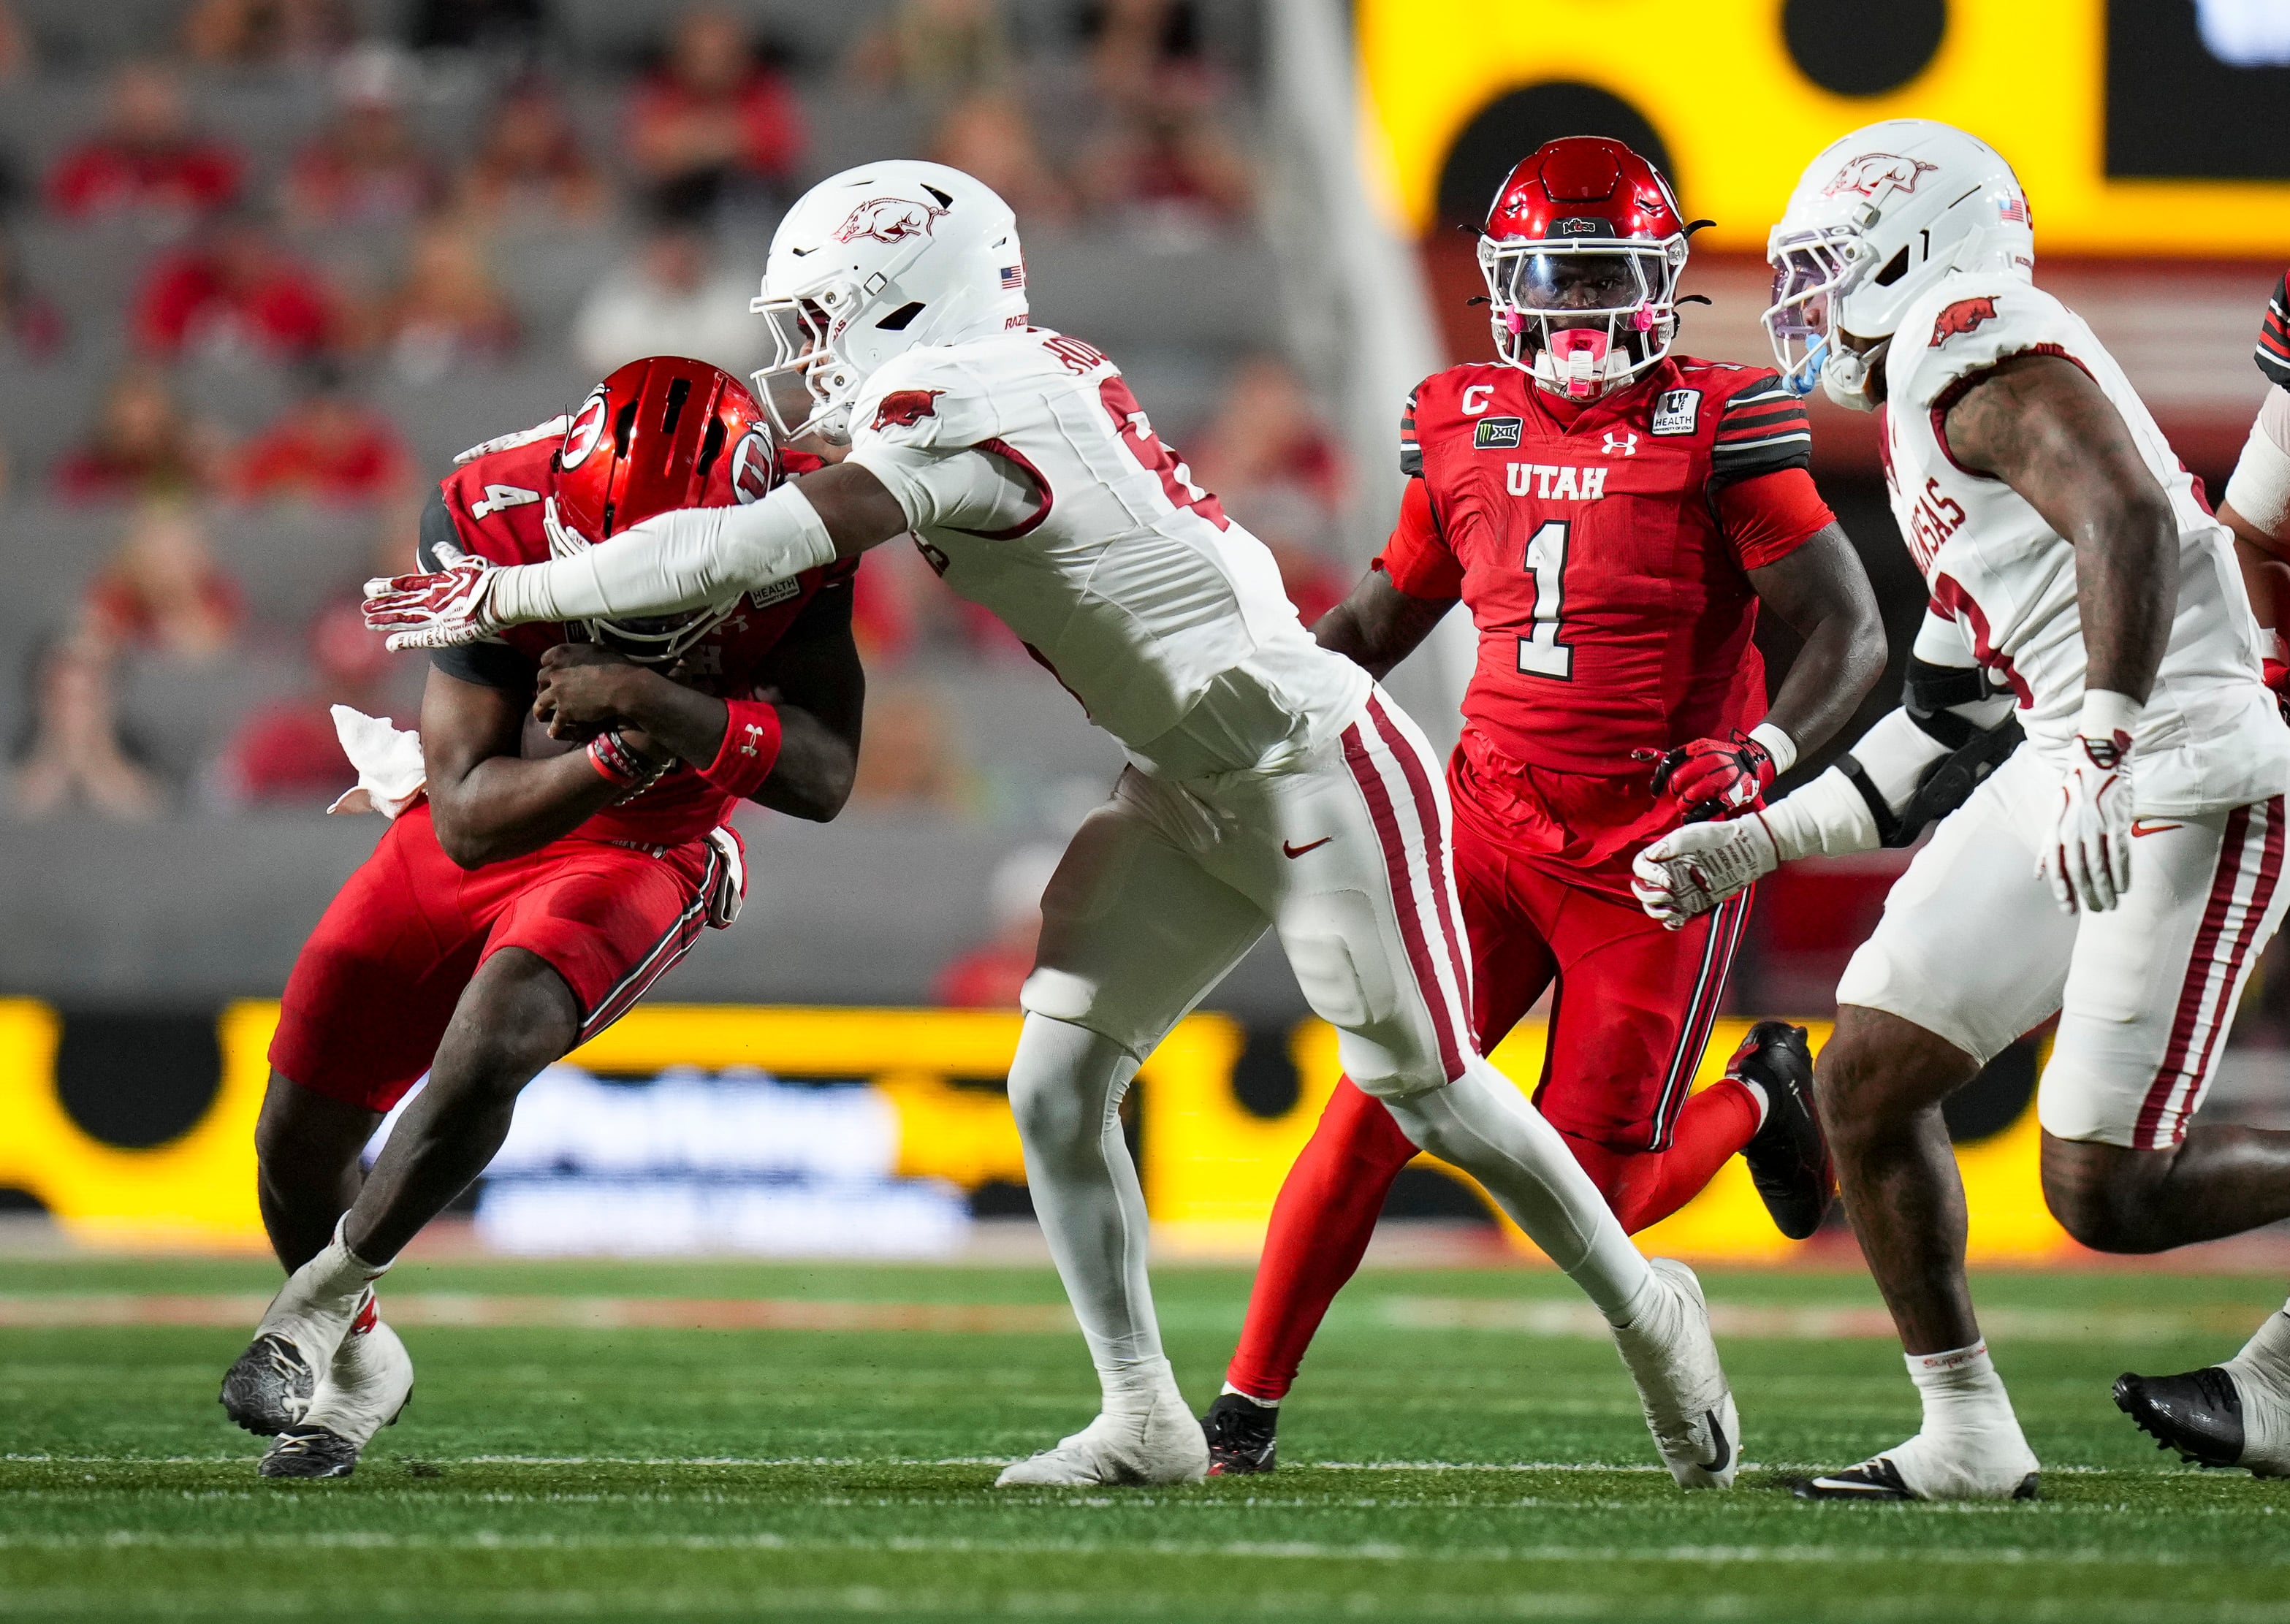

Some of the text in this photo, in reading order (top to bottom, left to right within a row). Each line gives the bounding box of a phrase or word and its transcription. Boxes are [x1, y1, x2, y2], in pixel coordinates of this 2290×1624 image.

[1461, 384, 1494, 415] C
[1655, 416, 1692, 427] HEALTH
[1506, 462, 1608, 500] UTAH
[470, 483, 541, 522] 4
[753, 578, 796, 601] HEALTH
[1516, 519, 1574, 682] 1
